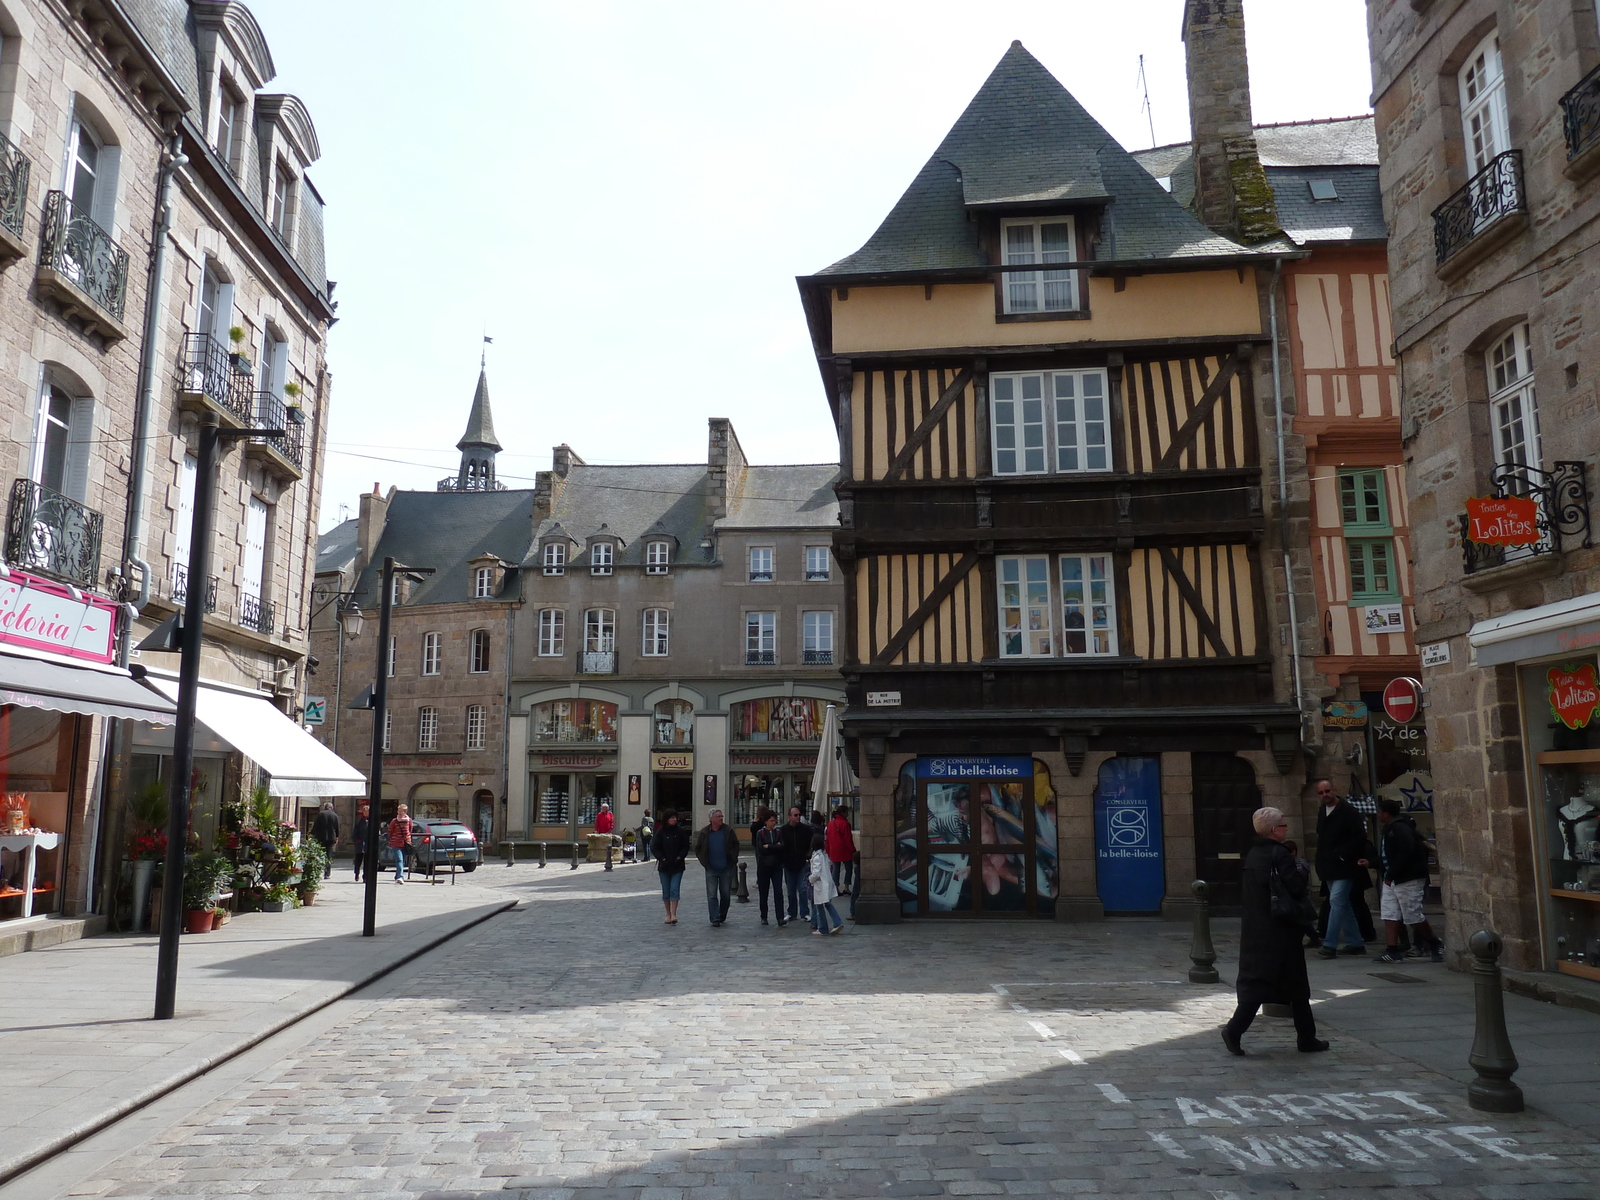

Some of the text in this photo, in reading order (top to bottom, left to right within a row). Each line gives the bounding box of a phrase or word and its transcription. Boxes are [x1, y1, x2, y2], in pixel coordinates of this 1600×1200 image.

[1478, 502, 1507, 513] Toutes
[1506, 509, 1519, 519] des
[1472, 516, 1532, 539] Lolitas
[1424, 654, 1447, 665] CORDELIERS
[1553, 685, 1596, 709] Lolitas
[1399, 725, 1419, 740] de
[541, 755, 604, 765] Biscuiterie
[732, 754, 818, 767] Produits régio
[947, 765, 1019, 776] la belle-iloise
[1099, 849, 1159, 858] la belle-iloise
[1175, 1090, 1450, 1126] ARRET
